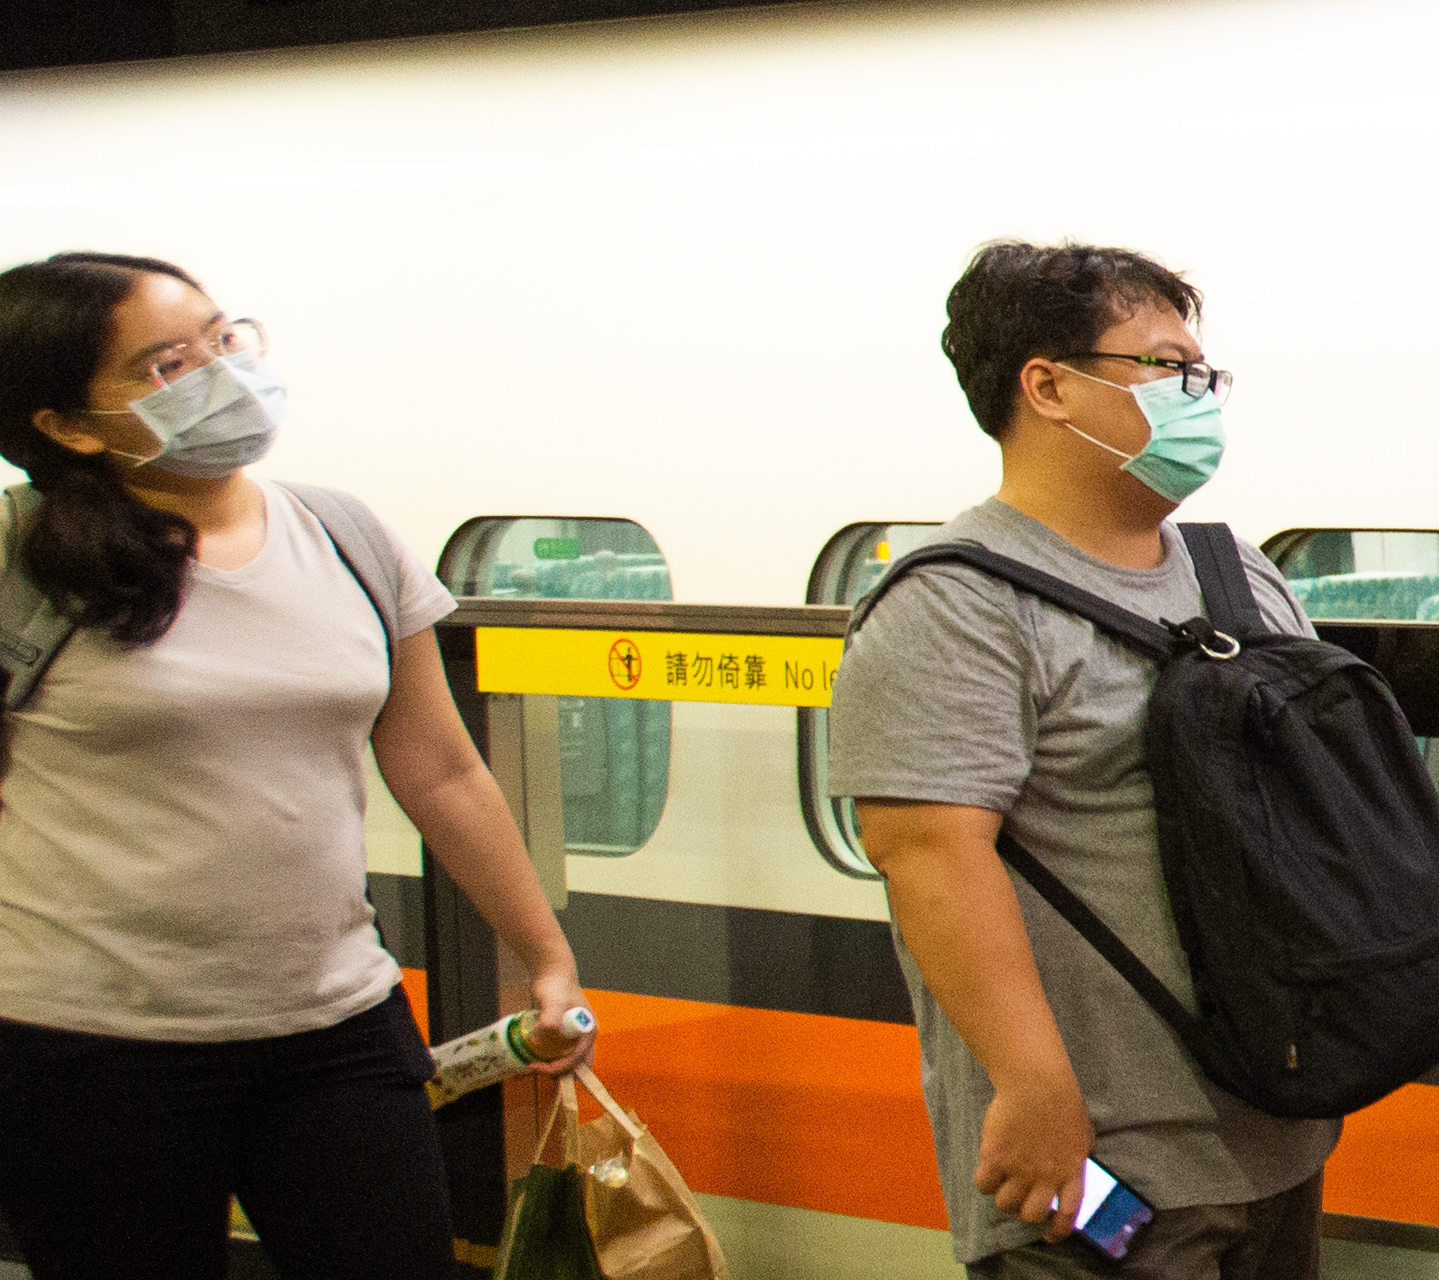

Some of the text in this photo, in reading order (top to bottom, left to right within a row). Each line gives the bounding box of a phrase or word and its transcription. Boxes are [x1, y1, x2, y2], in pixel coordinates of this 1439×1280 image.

[665, 651, 767, 690] 請勿倚靠
[785, 661, 814, 690] No
